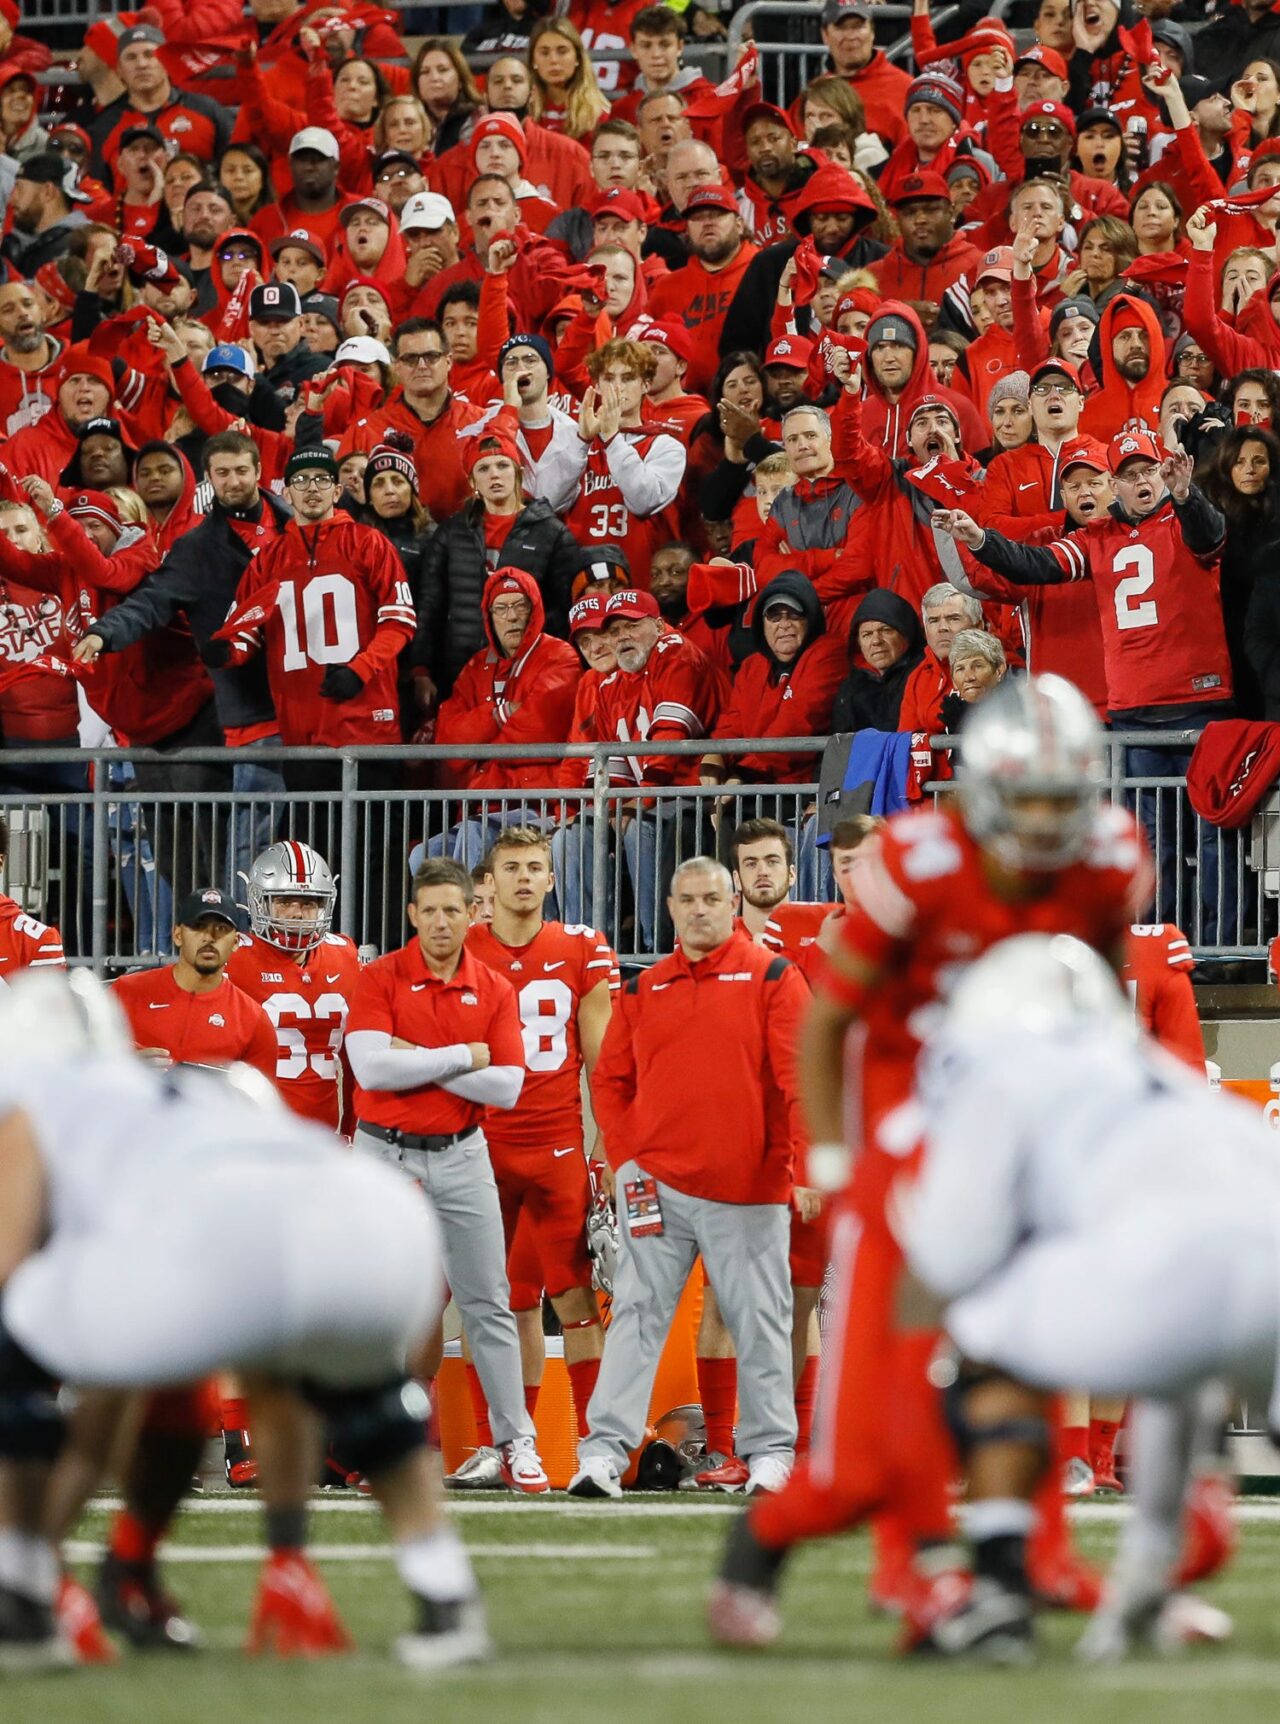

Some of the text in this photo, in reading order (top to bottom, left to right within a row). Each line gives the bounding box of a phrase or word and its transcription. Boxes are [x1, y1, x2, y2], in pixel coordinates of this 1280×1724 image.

[589, 503, 629, 537] 33
[275, 573, 360, 671] 10
[395, 581, 414, 605] 10
[1113, 543, 1159, 630] 2
[261, 992, 350, 1080] 63
